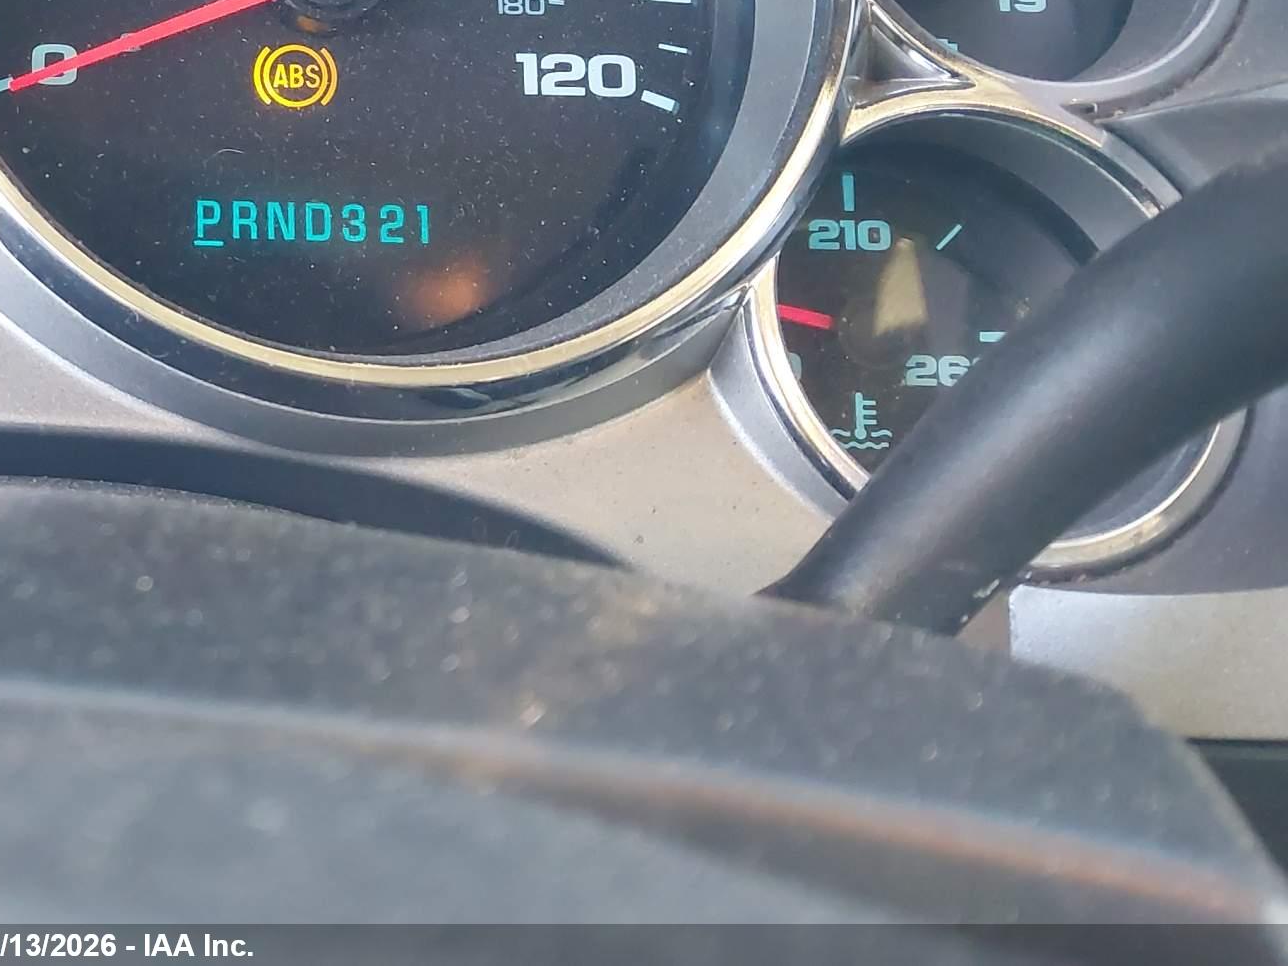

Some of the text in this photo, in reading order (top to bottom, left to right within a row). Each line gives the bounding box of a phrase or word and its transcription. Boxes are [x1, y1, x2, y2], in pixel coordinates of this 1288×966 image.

[32, 43, 77, 85] 0
[273, 64, 321, 89] ABS
[515, 53, 637, 98] 120
[808, 219, 891, 251] 210
[906, 355, 981, 387] 26
